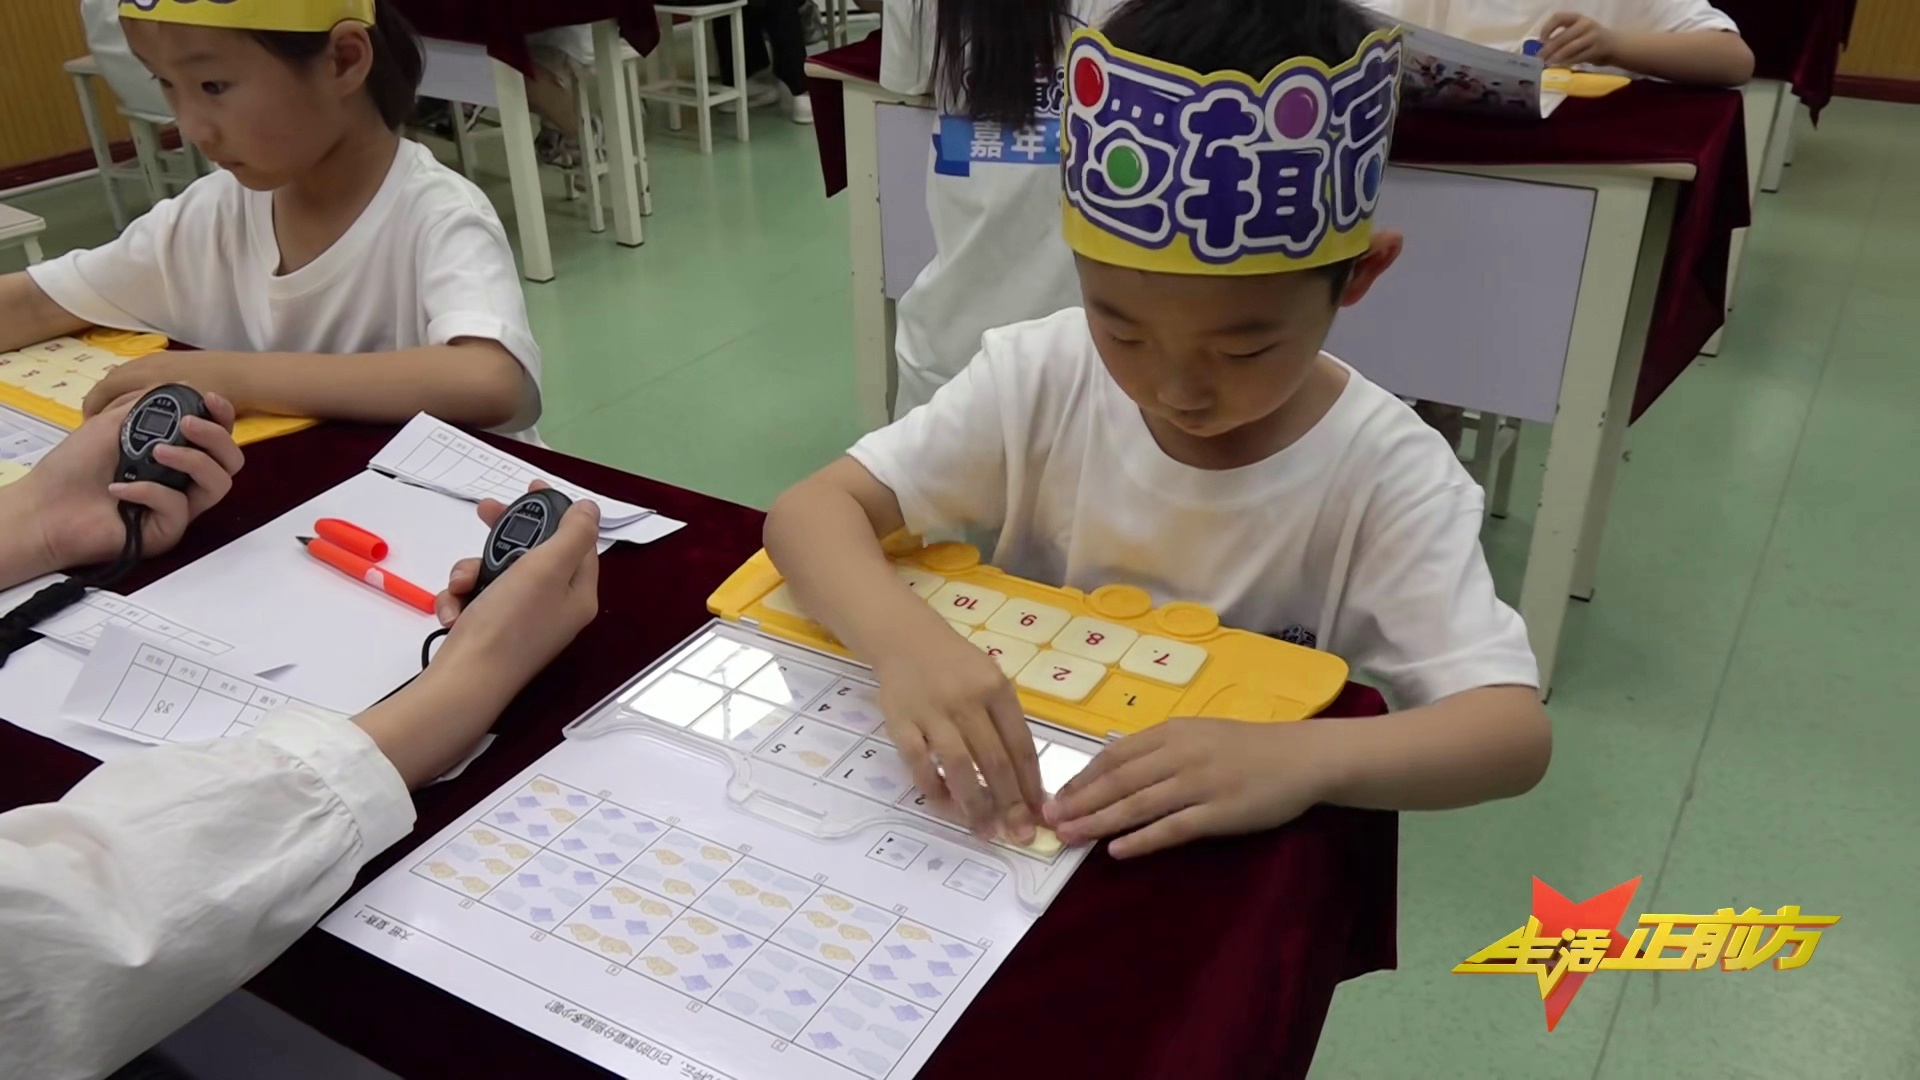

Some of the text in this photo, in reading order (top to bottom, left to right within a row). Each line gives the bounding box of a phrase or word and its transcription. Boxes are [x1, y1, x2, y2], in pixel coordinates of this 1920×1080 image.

[970, 119, 1060, 160] 嘉年
[953, 593, 978, 611] 10.
[1020, 611, 1038, 627] 9.
[1086, 629, 1105, 646] 8.
[1153, 650, 1171, 667] 7.
[1053, 666, 1072, 682] 2.
[837, 686, 852, 697] 2
[1124, 693, 1137, 707] 1.
[818, 702, 831, 713] 4
[794, 725, 804, 735] 1
[770, 742, 787, 754] 5
[861, 748, 877, 760] 5
[843, 768, 854, 779] 1
